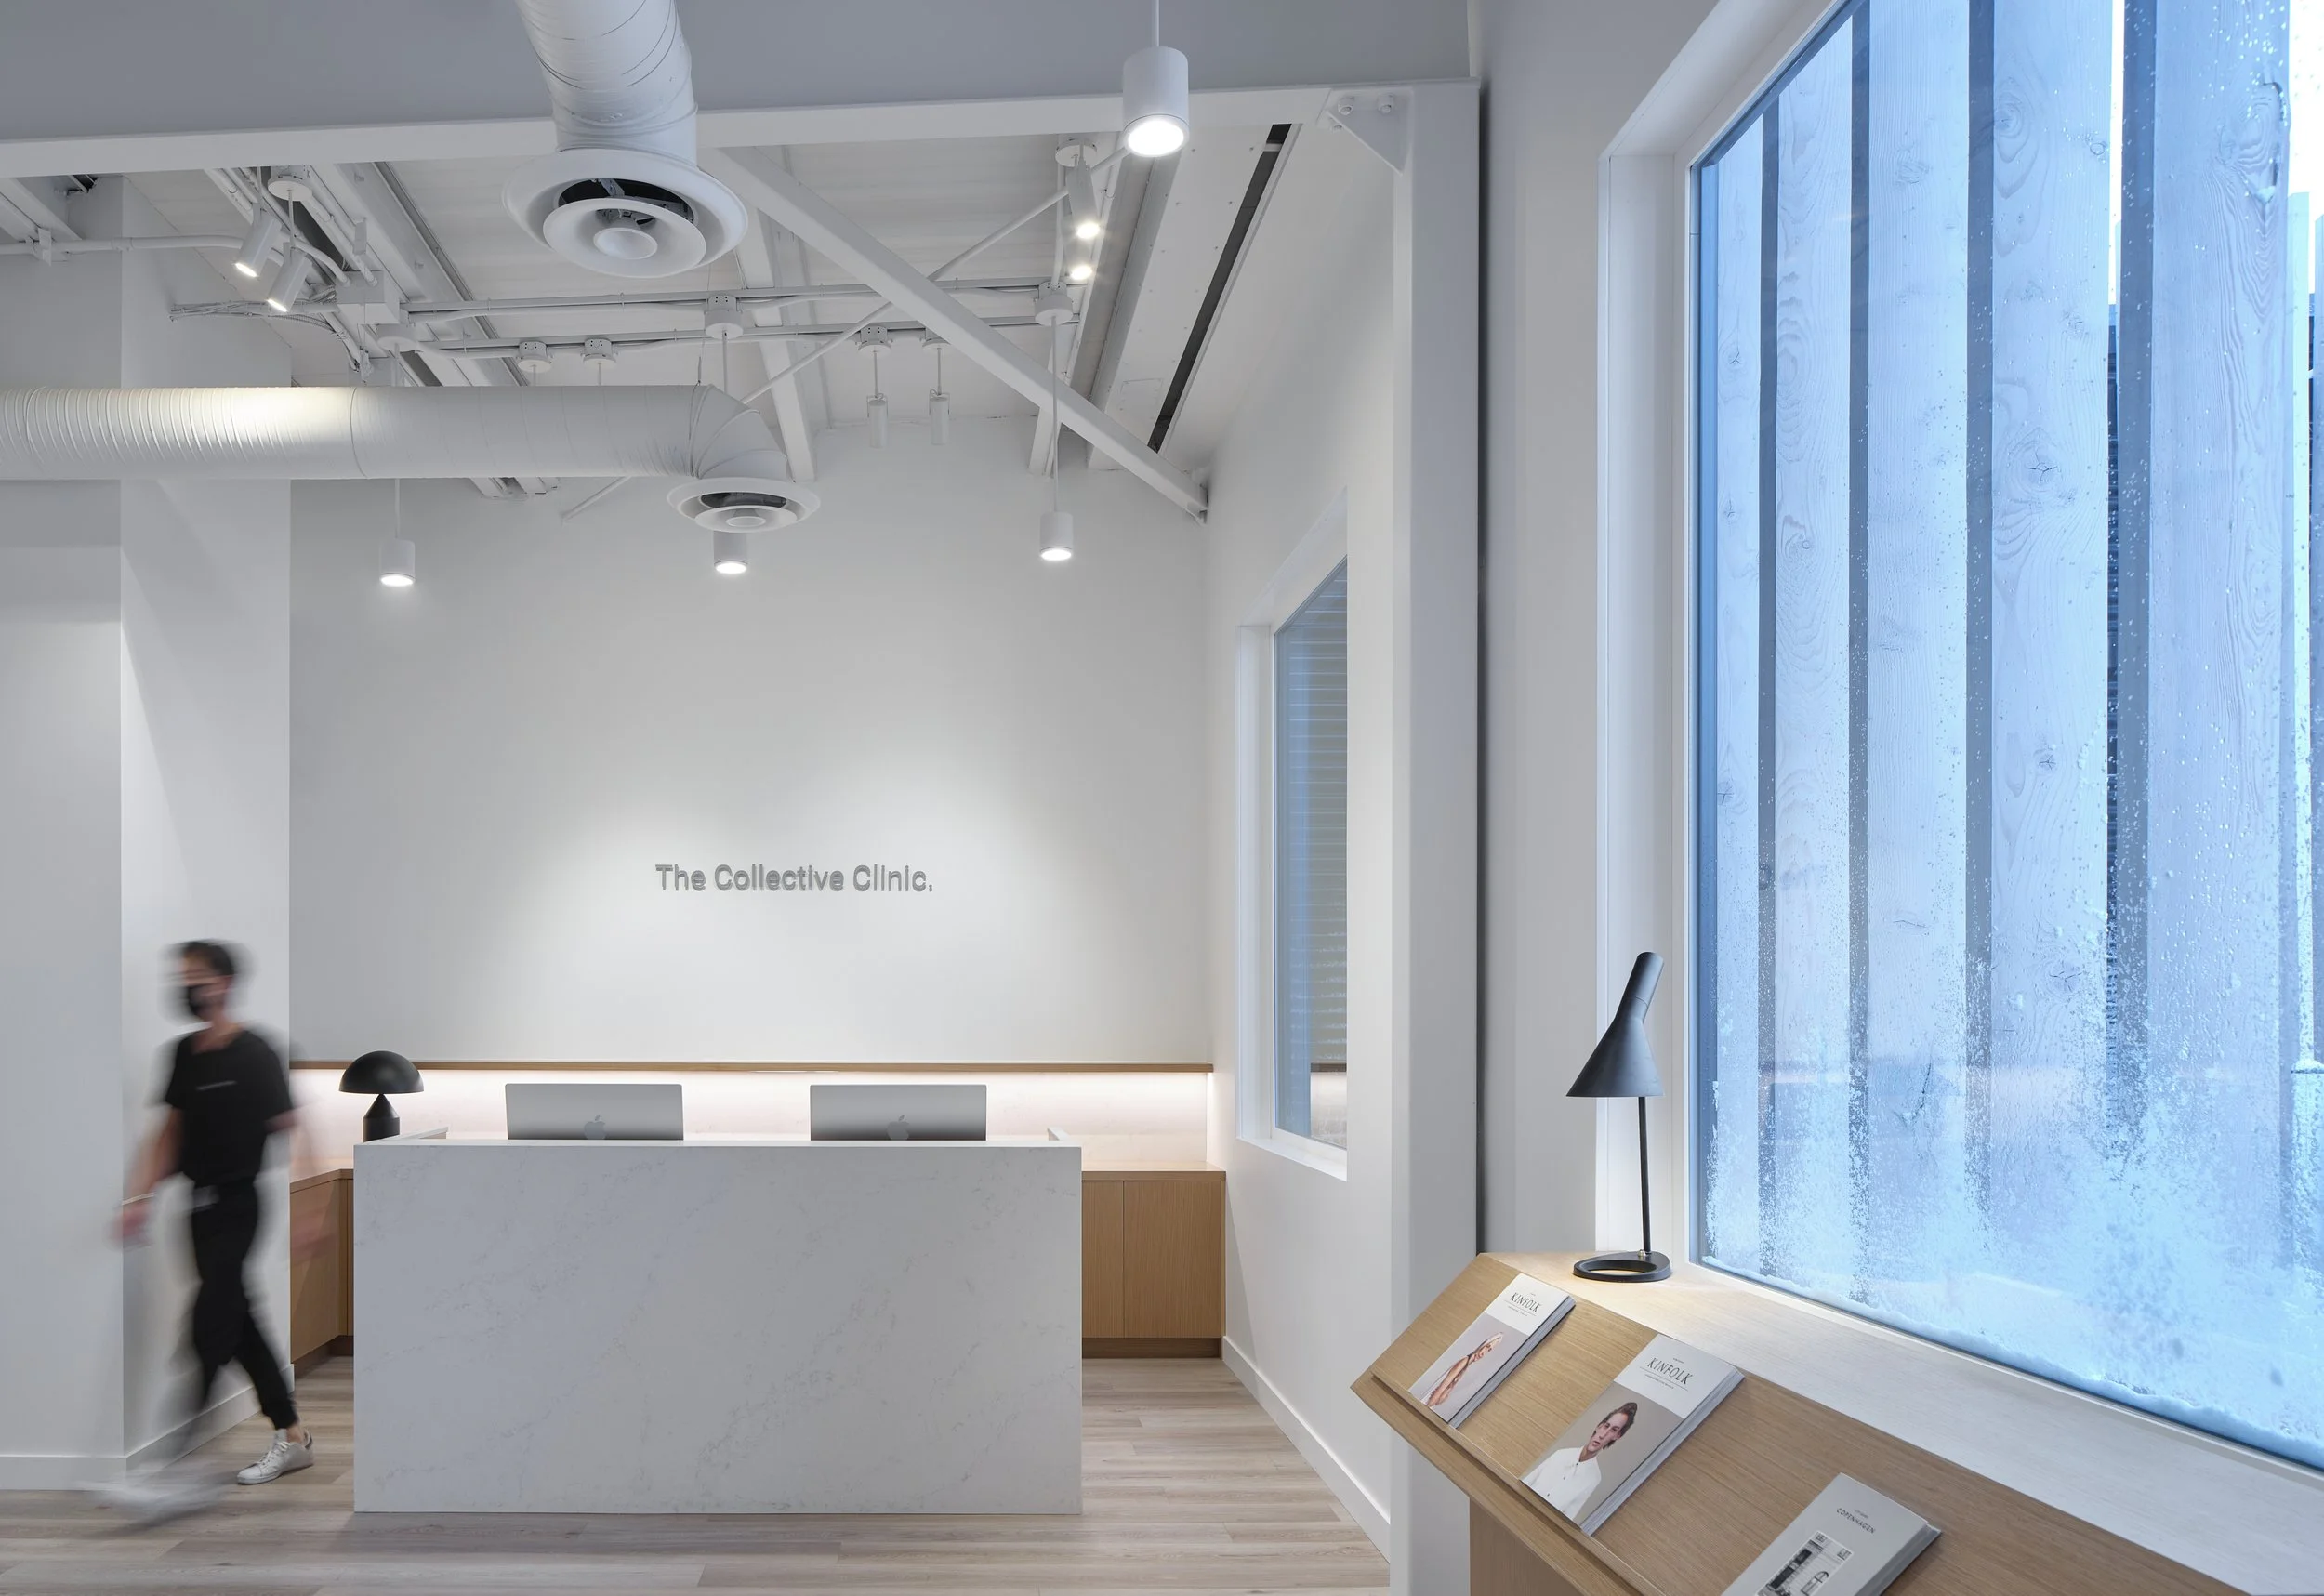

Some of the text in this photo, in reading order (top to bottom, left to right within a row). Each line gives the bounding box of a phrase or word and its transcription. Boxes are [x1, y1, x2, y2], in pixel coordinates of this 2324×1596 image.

[655, 863, 933, 892] The Collective Clinic.
[1510, 1292, 1541, 1312] KINFOLK
[1647, 1357, 1693, 1385] KINFOLK
[1836, 1507, 1876, 1534] COPENHAGEN
